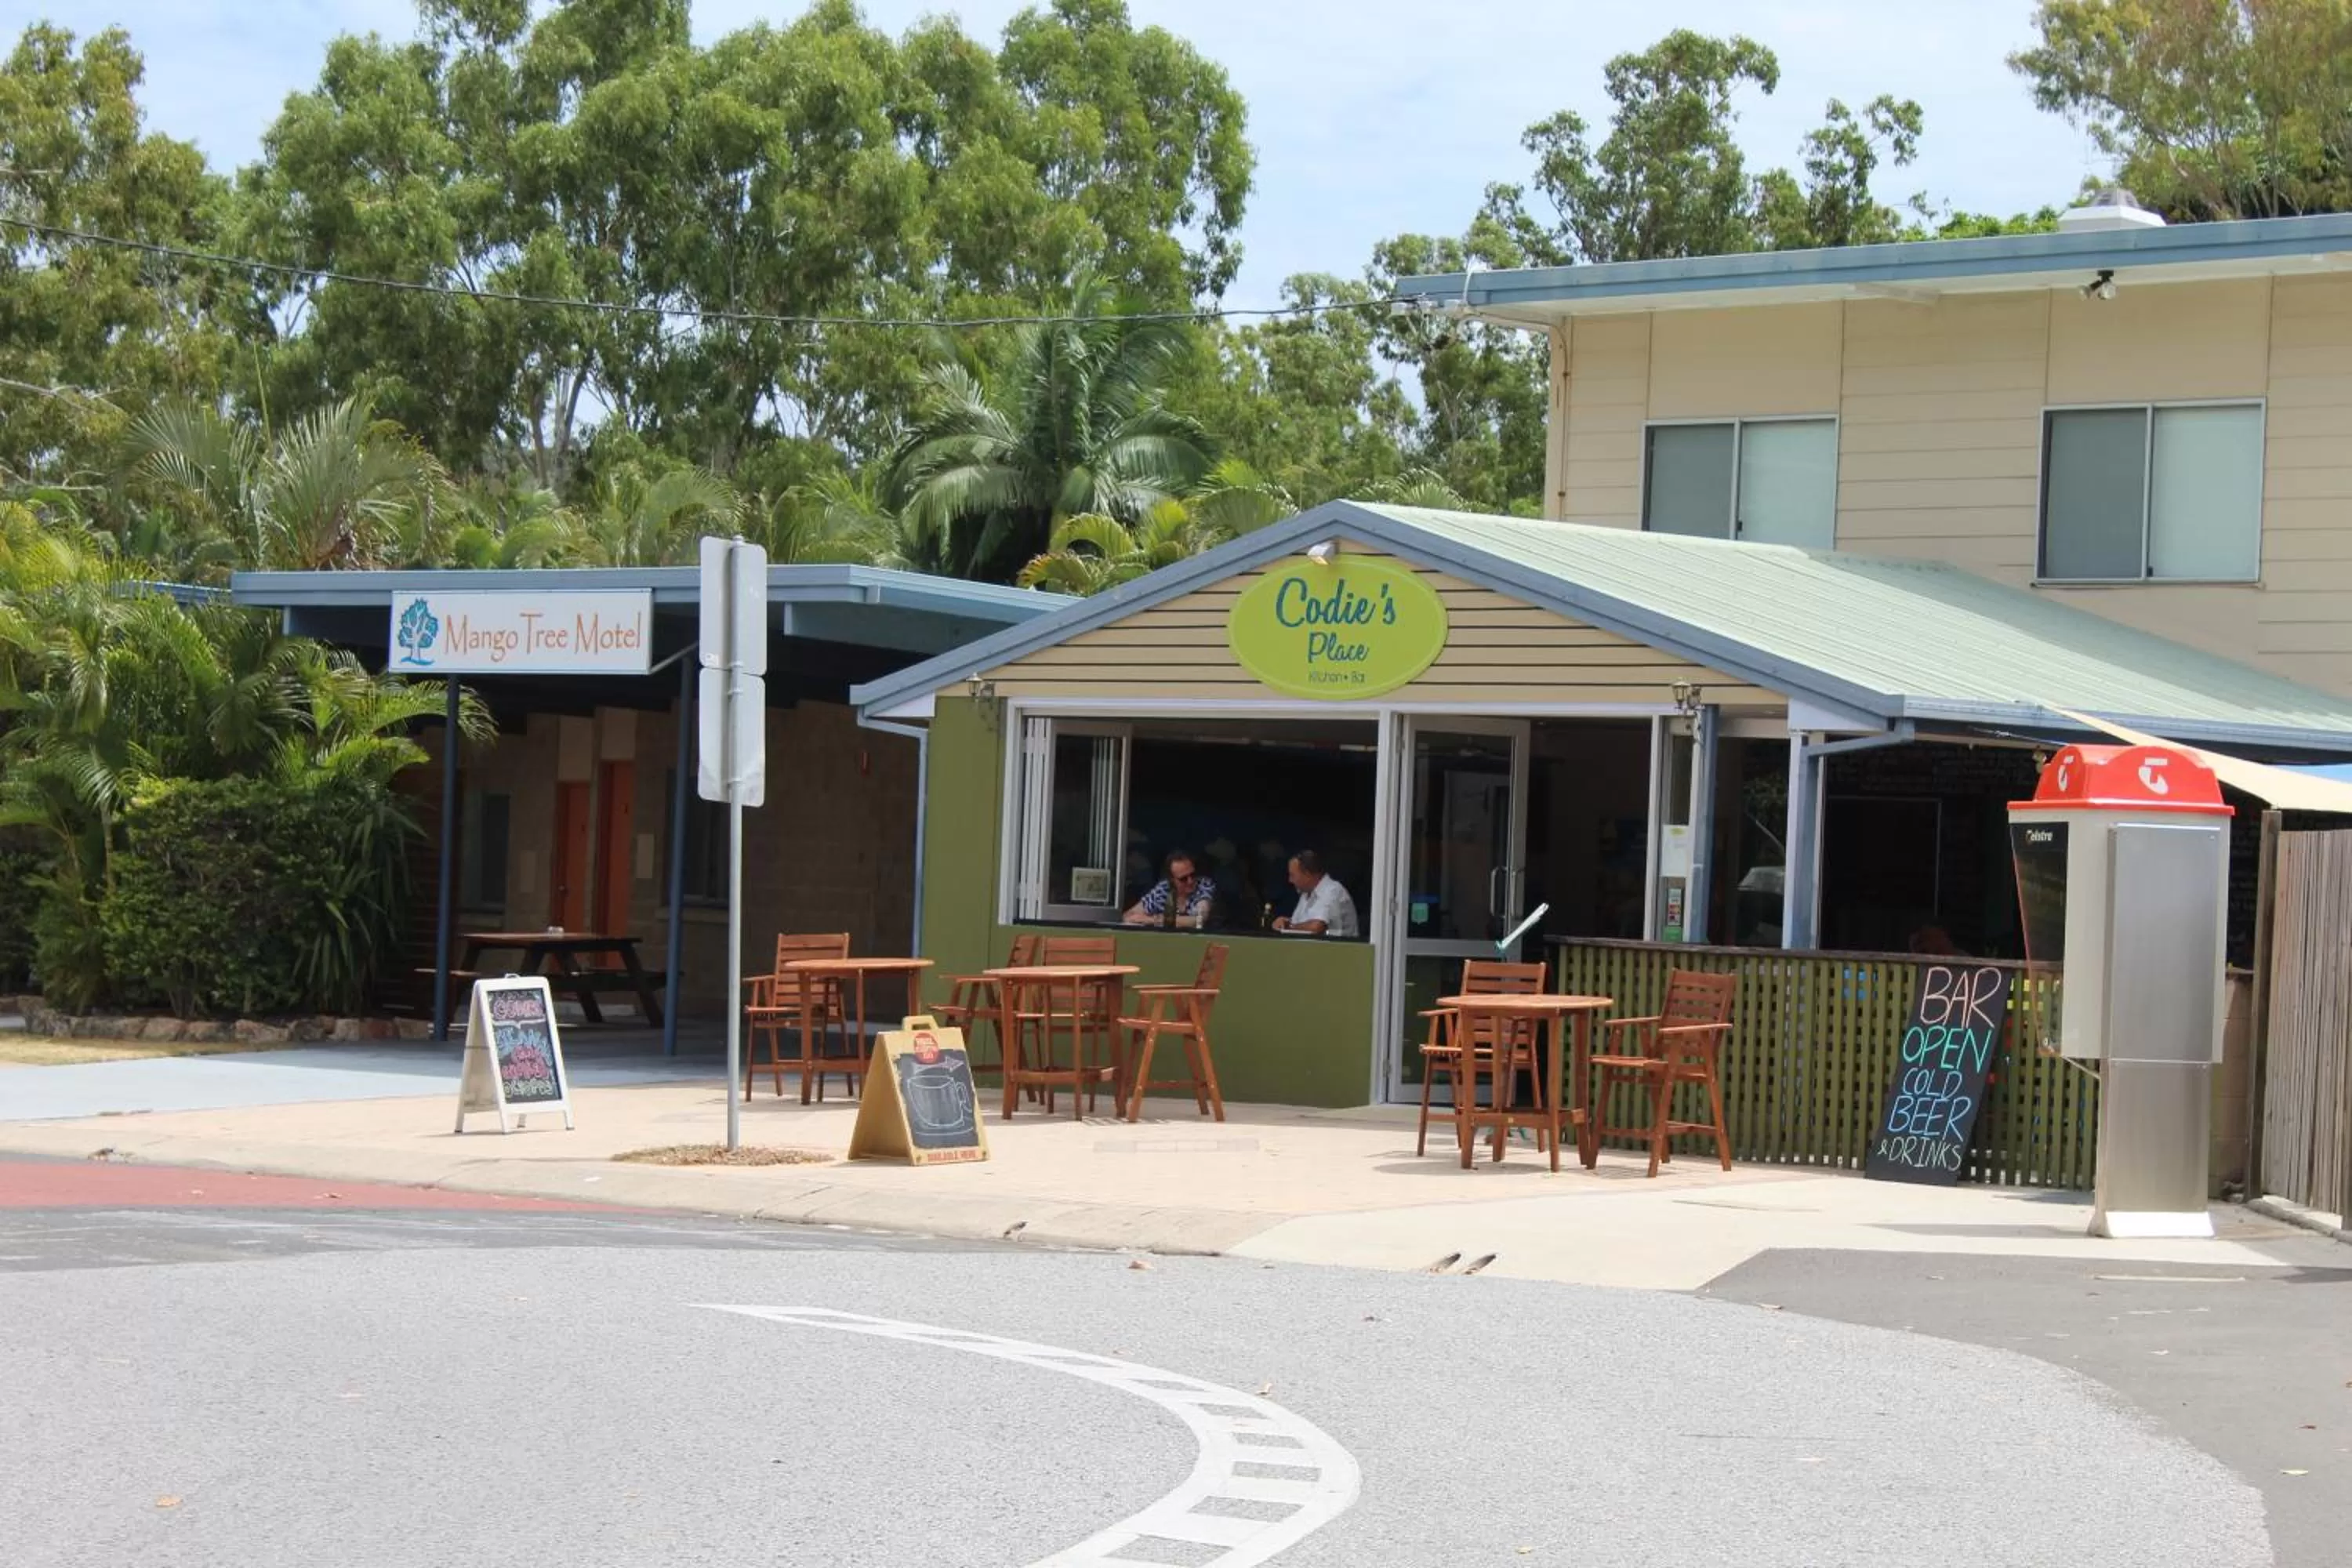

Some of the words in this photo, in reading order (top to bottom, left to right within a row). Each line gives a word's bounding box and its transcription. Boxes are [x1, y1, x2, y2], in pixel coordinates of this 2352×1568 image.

[1276, 577, 1396, 628] Codie's
[444, 614, 518, 662] Mango
[519, 612, 568, 655] Tree
[574, 611, 642, 656] Motel
[1307, 632, 1368, 663] Place
[1920, 966, 2002, 1029] BAR
[1902, 1025, 1993, 1073] OPEN
[1902, 1067, 1962, 1099] COLD
[1887, 1095, 1972, 1143] BEER
